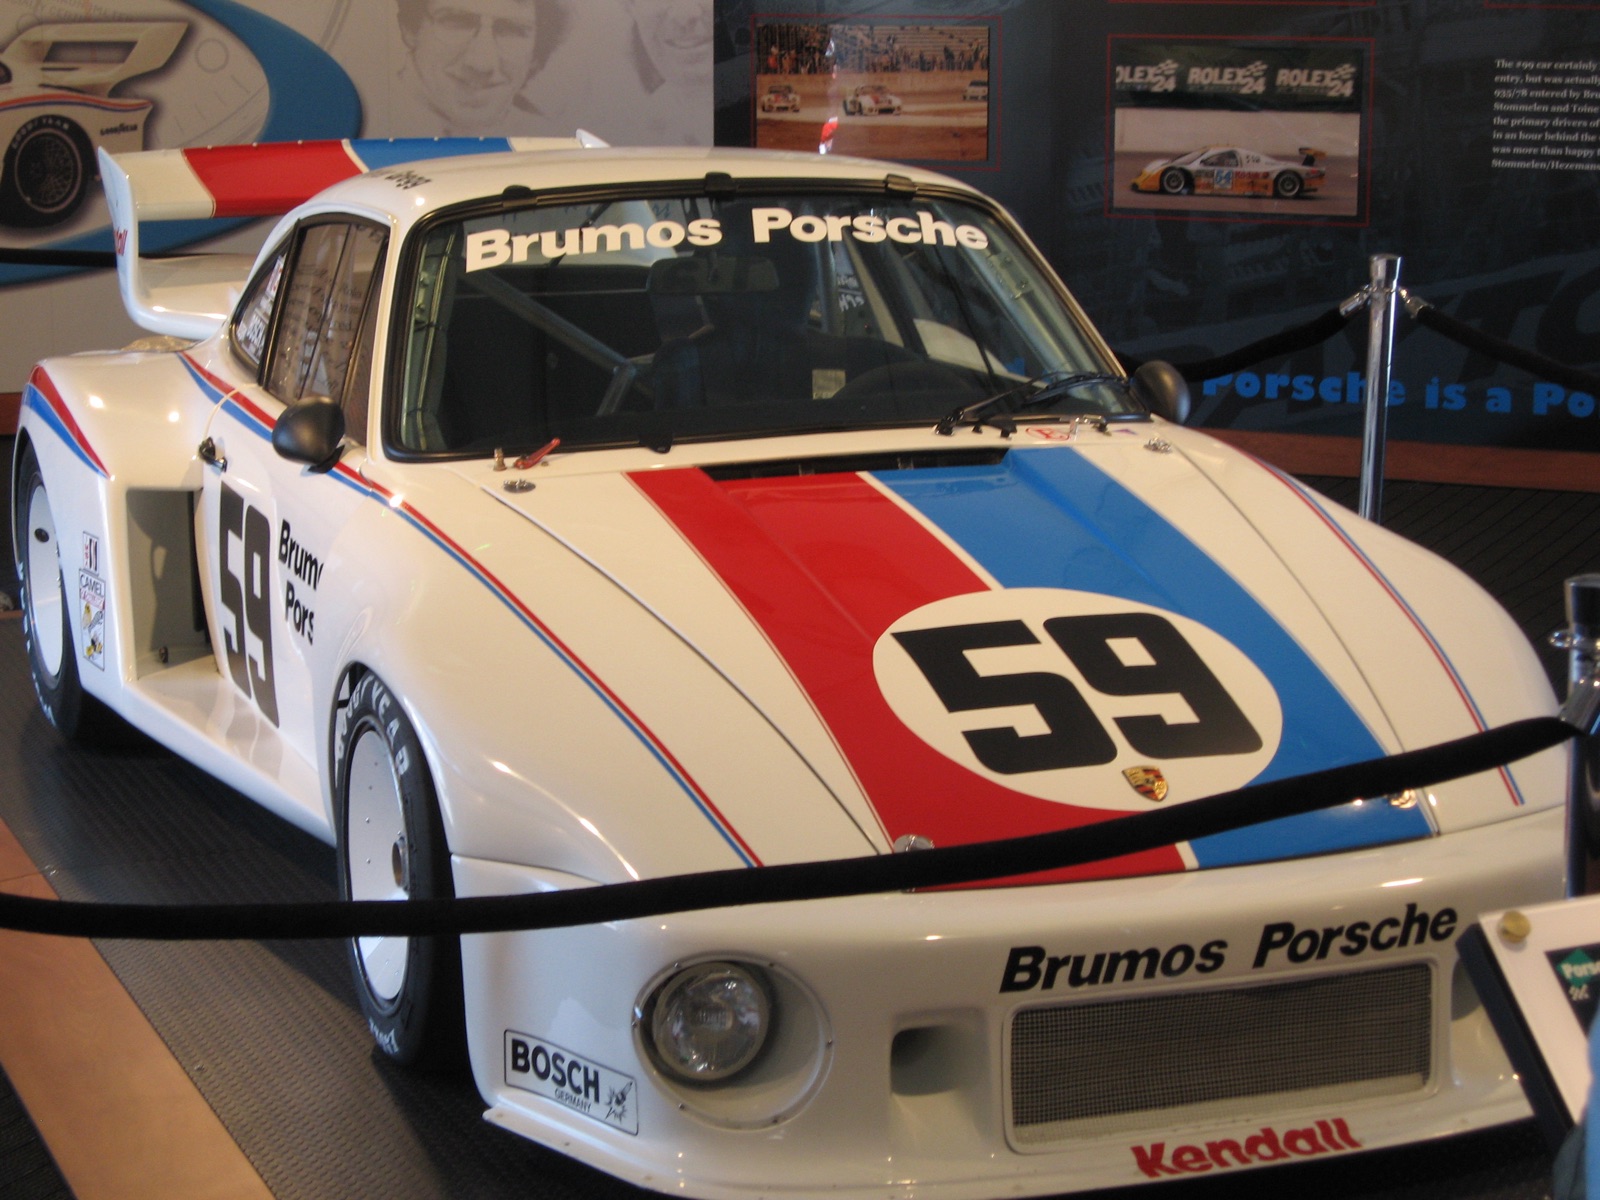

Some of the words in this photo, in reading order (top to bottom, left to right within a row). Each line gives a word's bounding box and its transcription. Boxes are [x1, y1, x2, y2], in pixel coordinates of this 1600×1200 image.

[1495, 59, 1514, 69] The
[1536, 62, 1552, 70] car
[1554, 61, 1597, 72] certainly
[1152, 75, 1177, 92] 24
[1187, 67, 1247, 85] ROLEX
[1240, 77, 1267, 94] 24
[1275, 68, 1335, 87] ROLEX
[1327, 79, 1354, 97] 24
[1494, 75, 1523, 85] entry,
[1525, 74, 1541, 83] but
[1544, 76, 1562, 84] was
[1529, 90, 1567, 99] entered
[1569, 90, 1580, 100] by
[1550, 103, 1569, 113] and
[1493, 117, 1509, 126] the
[1510, 117, 1550, 128] primary
[1552, 118, 1587, 128] drivers
[1492, 130, 1503, 140] in
[1504, 131, 1517, 139] an
[1519, 131, 1542, 140] hour
[1544, 130, 1579, 141] behind
[1580, 132, 1597, 142] the
[1492, 146, 1511, 154] was
[1513, 147, 1539, 155] more
[1541, 145, 1562, 155] than
[1565, 146, 1595, 158] happy
[466, 218, 723, 273] Brumos
[752, 207, 988, 250] Porsche
[1202, 371, 1406, 406] Porsche
[1425, 377, 1466, 411] is
[1486, 387, 1511, 414] a
[219, 480, 279, 728] 59
[890, 612, 1263, 775] 59
[999, 939, 1228, 994] Brumos
[1252, 903, 1458, 969] Porsche
[511, 1038, 600, 1104] BOSCH
[554, 1088, 592, 1113] GERMANY
[1130, 1117, 1364, 1179] Kendall
